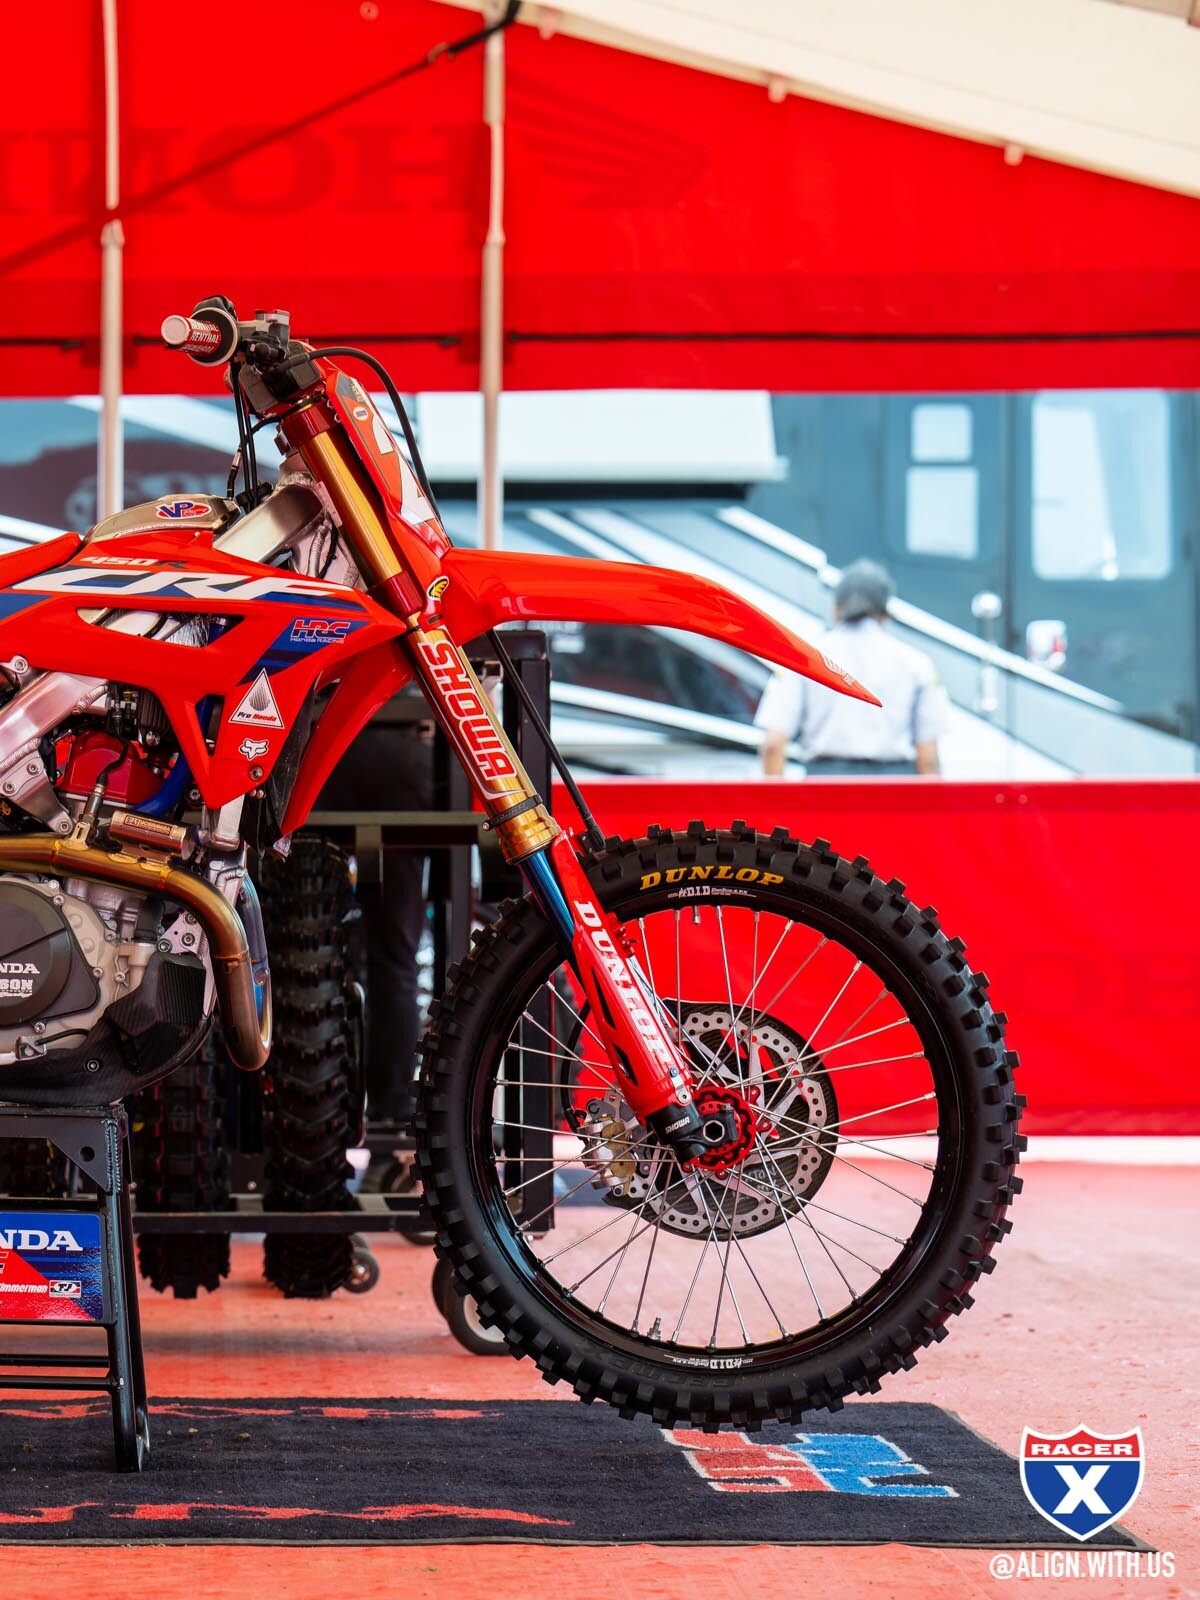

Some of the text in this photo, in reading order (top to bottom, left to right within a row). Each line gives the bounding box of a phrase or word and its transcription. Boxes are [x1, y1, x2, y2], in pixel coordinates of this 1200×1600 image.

[159, 501, 194, 518] VP
[11, 565, 355, 601] CRF
[291, 619, 351, 639] HRC
[237, 711, 251, 719] Pro
[252, 713, 277, 722] Honda
[417, 639, 517, 782] SHOWA
[639, 865, 785, 891] DUNLOP
[574, 900, 672, 1066] DUNLOP
[665, 1116, 690, 1134] SHOWA
